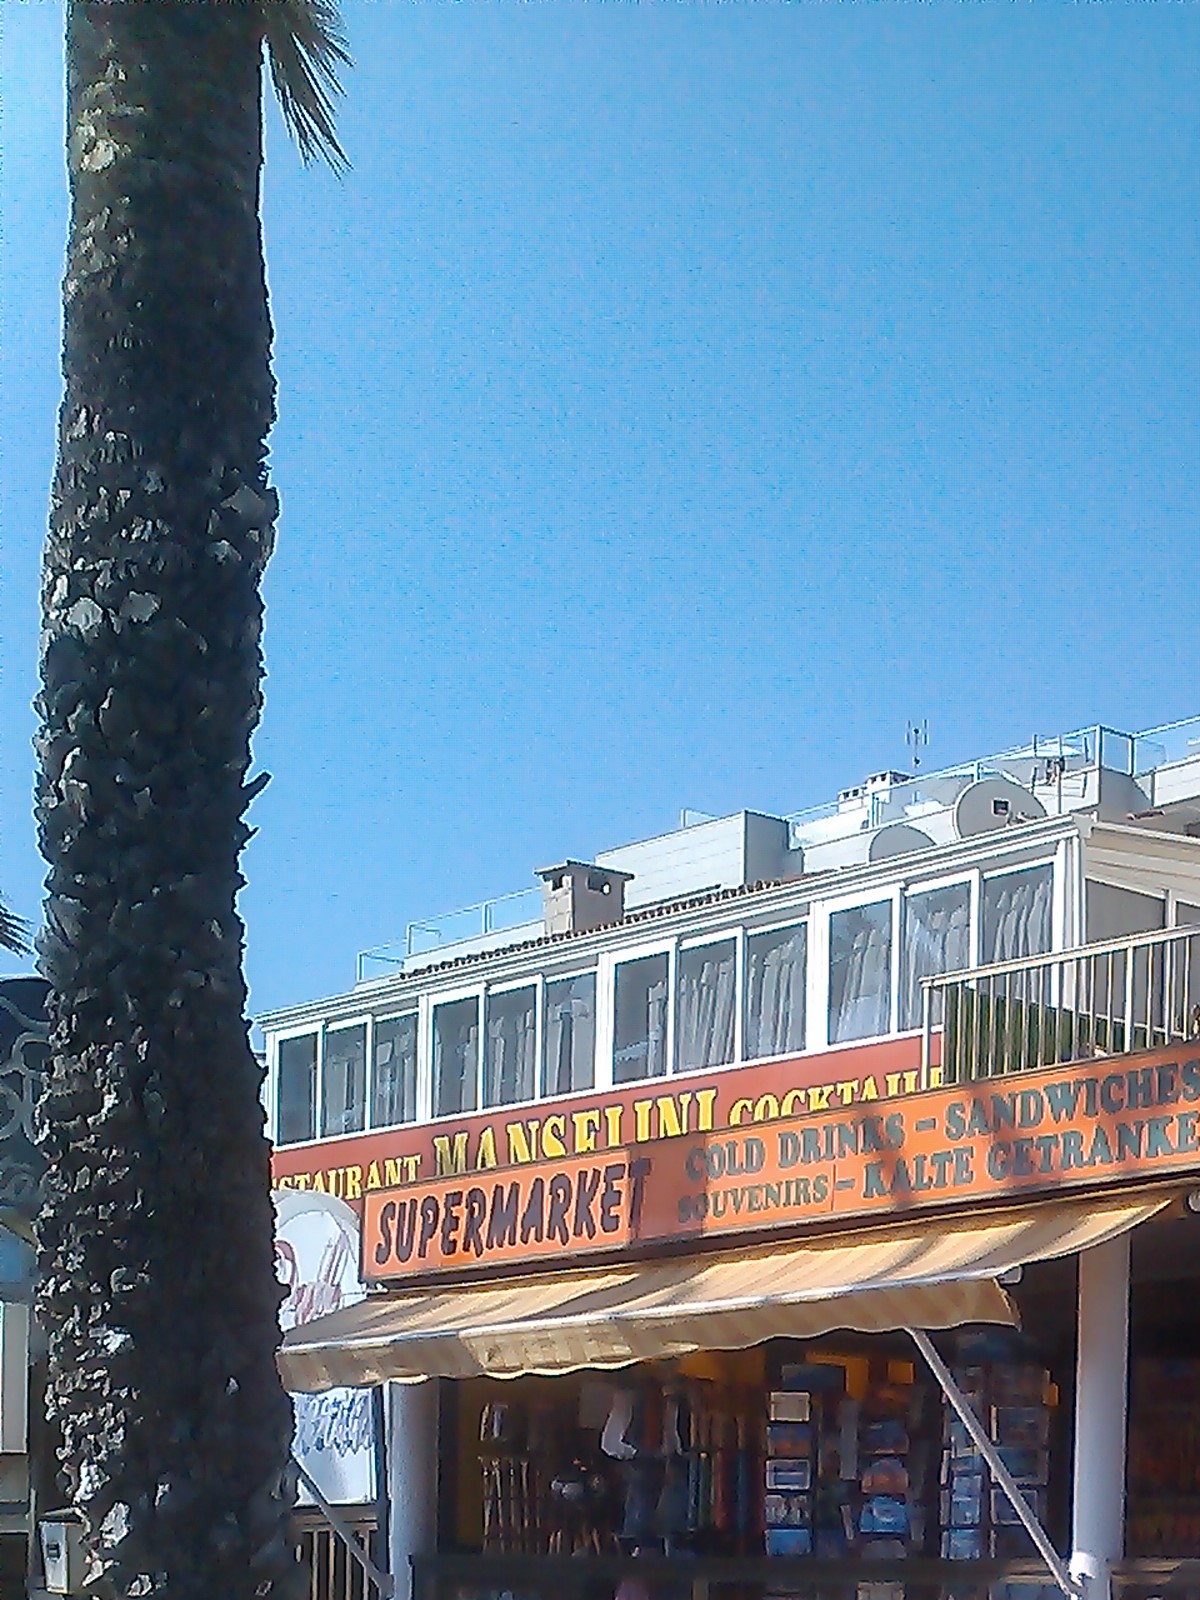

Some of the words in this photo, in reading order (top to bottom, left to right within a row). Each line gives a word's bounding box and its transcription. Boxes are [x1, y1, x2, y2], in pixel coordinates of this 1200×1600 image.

[271, 1154, 422, 1199] STAURANT
[678, 1174, 829, 1223] SOUVENIRS
[863, 1146, 974, 1198] KALTE
[987, 1110, 1200, 1181] GETRANKE
[686, 1138, 766, 1181] COLD
[778, 1112, 905, 1169] DRINKS
[375, 1157, 651, 1265] SUPERMARKET
